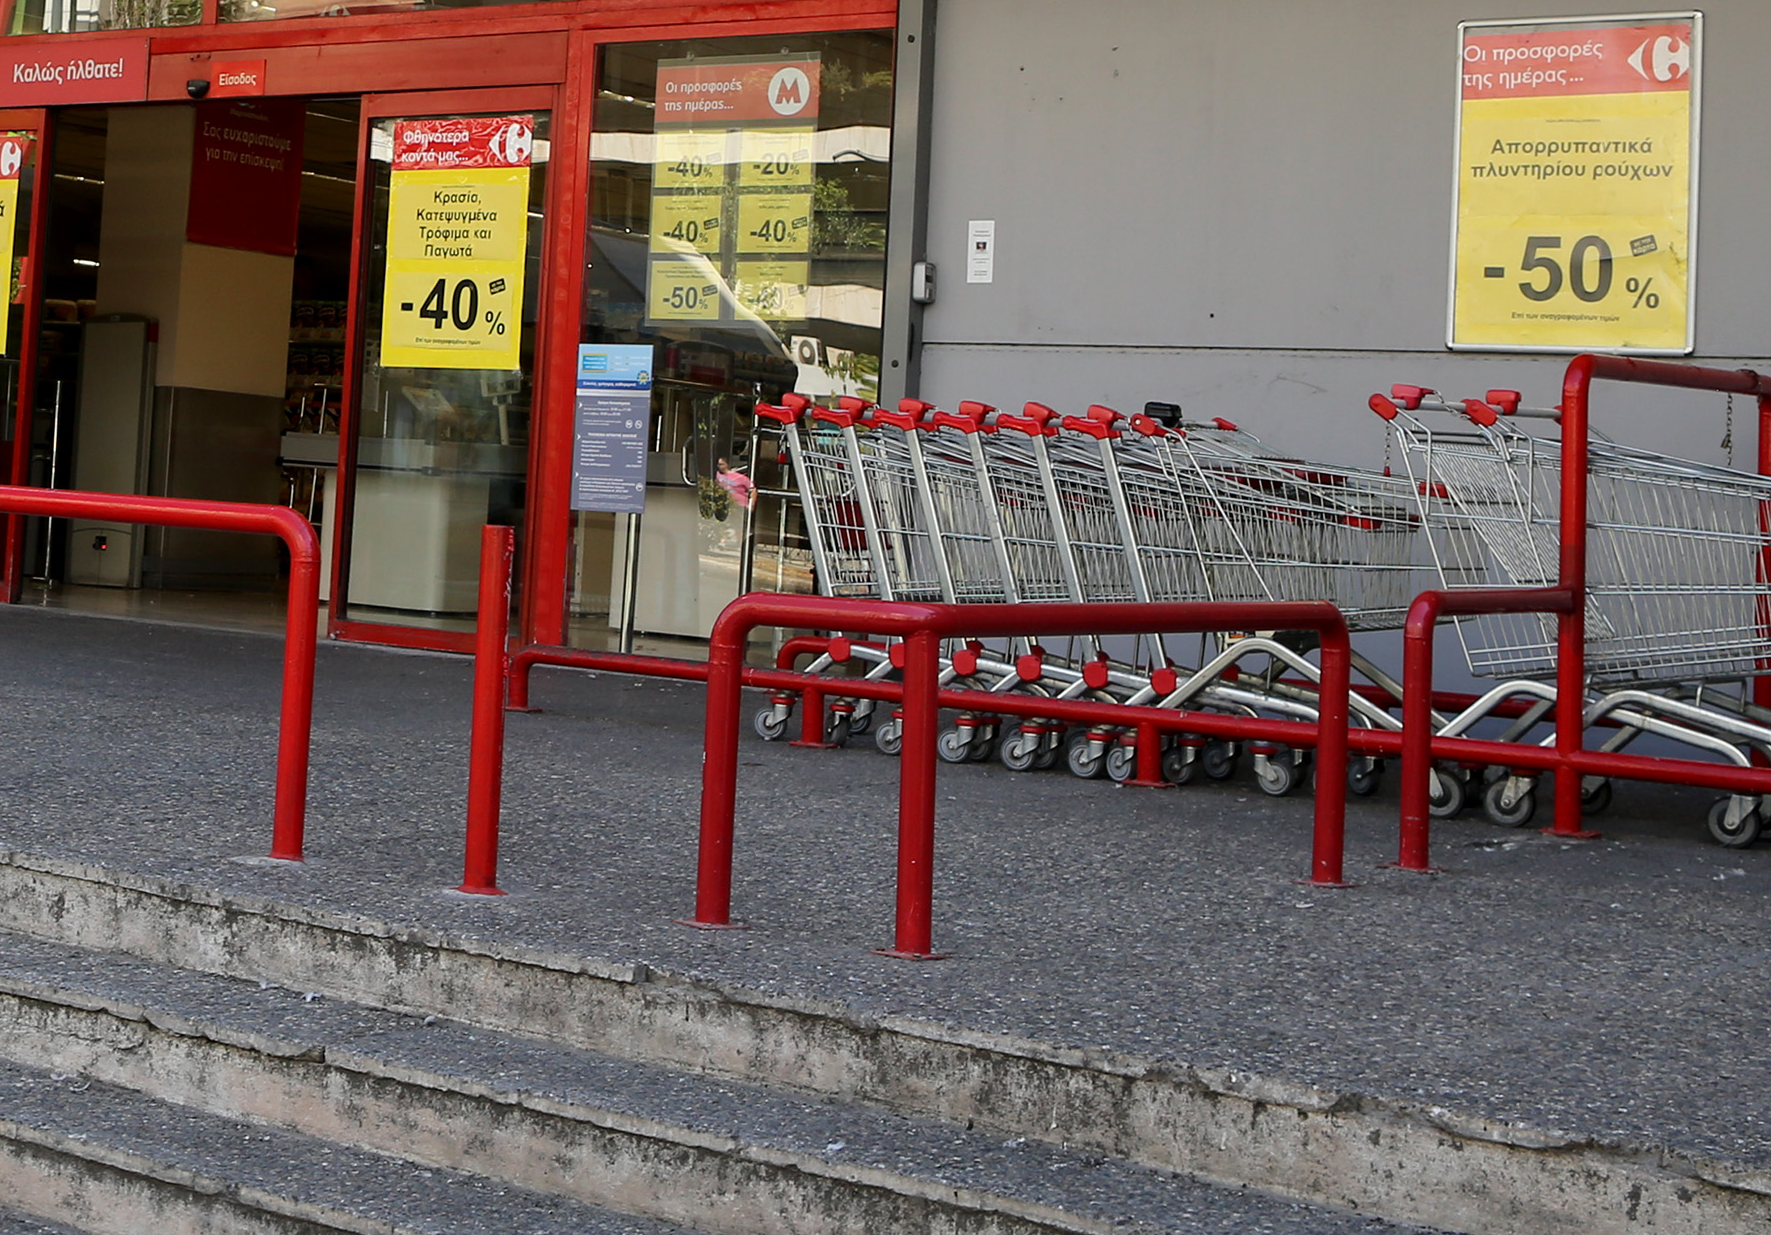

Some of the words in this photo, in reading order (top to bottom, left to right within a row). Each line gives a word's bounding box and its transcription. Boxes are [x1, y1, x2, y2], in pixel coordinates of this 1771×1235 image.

[1463, 44, 1487, 62] Οι
[1492, 40, 1604, 65] προσφορές
[12, 62, 64, 85] Καλώς
[66, 56, 124, 81] ήλθατε!
[218, 72, 257, 87] Είσοδος
[665, 81, 678, 93] Οι
[680, 77, 743, 95] προσφορές
[1463, 72, 1493, 91] της
[664, 100, 682, 112] της
[203, 121, 221, 141] Σας
[403, 129, 470, 147] Φθηνότερα
[401, 148, 435, 163] κοντά
[1490, 137, 1653, 158] Απορρυπαντικά
[1470, 161, 1586, 181] πλυντηρίου
[1592, 160, 1674, 181] ρούχων
[416, 209, 498, 224] Κατεψυγμένα
[419, 226, 470, 242] Τρόφιμα
[474, 228, 492, 240] και
[424, 244, 473, 259] Παγωτά
